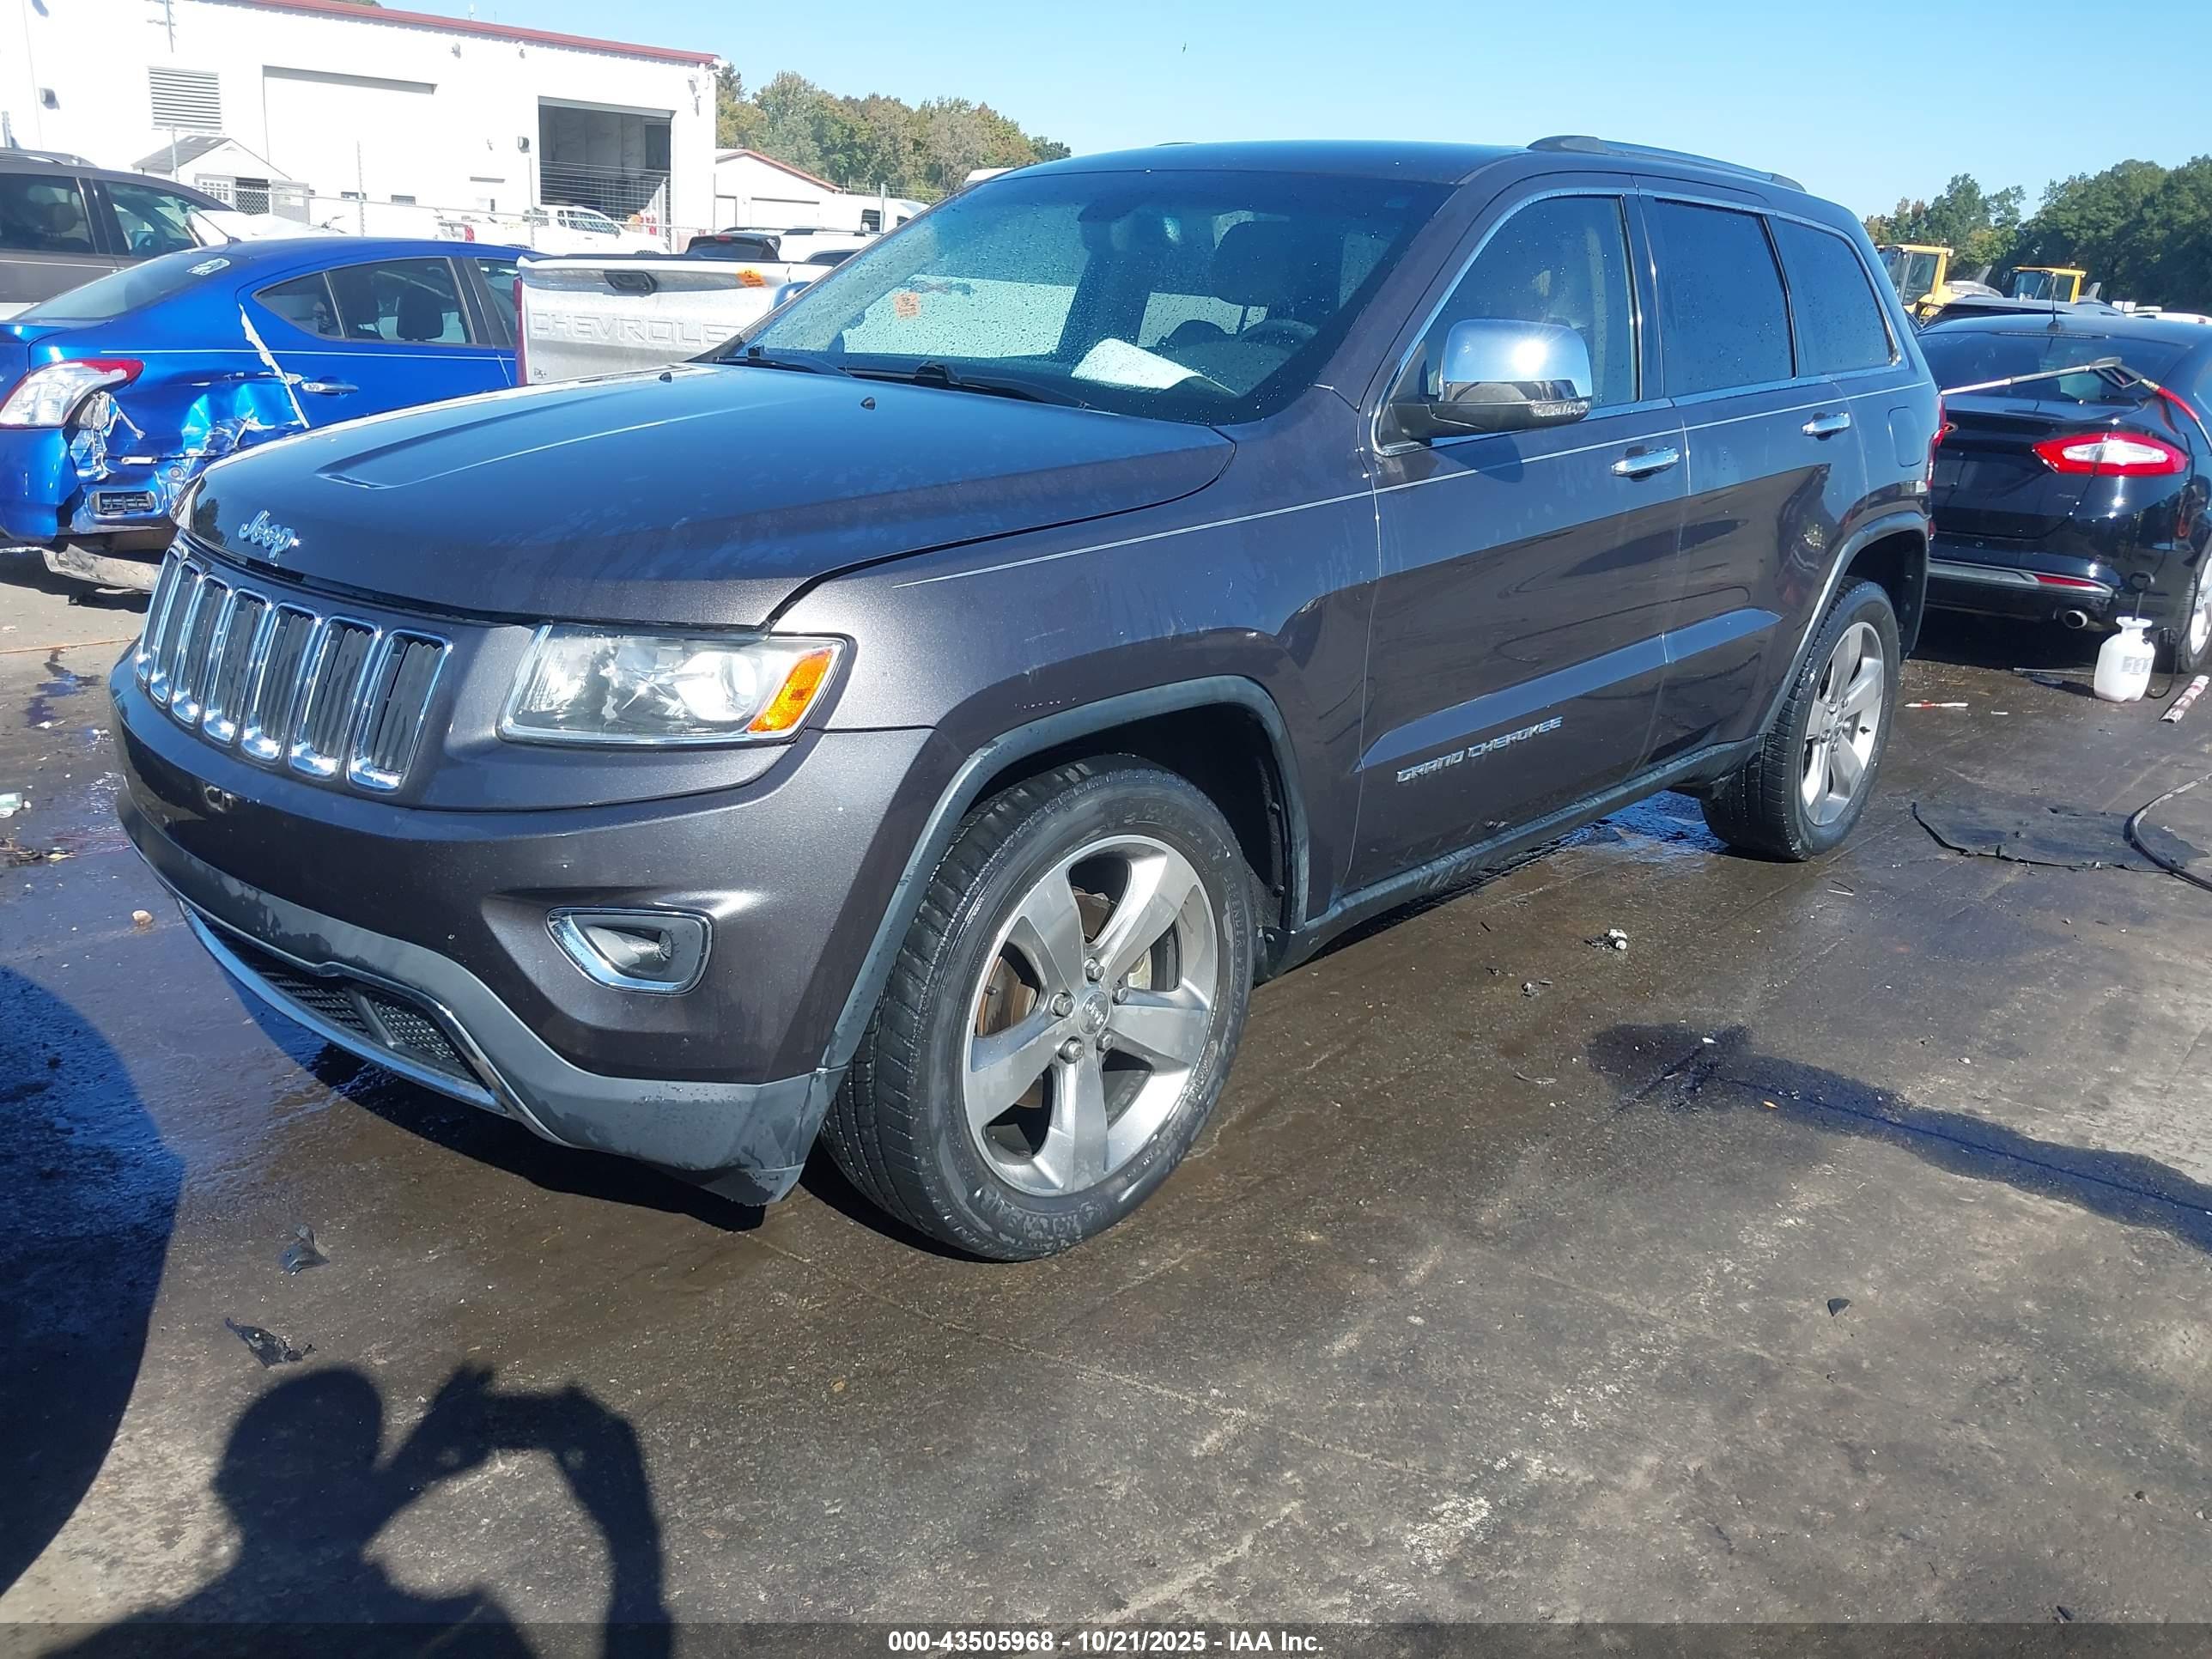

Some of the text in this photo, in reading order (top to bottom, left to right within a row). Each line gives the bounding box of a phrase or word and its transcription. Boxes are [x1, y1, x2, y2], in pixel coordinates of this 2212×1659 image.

[531, 312, 743, 346] CHEVROLE
[238, 509, 296, 559] Jeep
[1396, 715, 1563, 783] GRAND CHEROKEE
